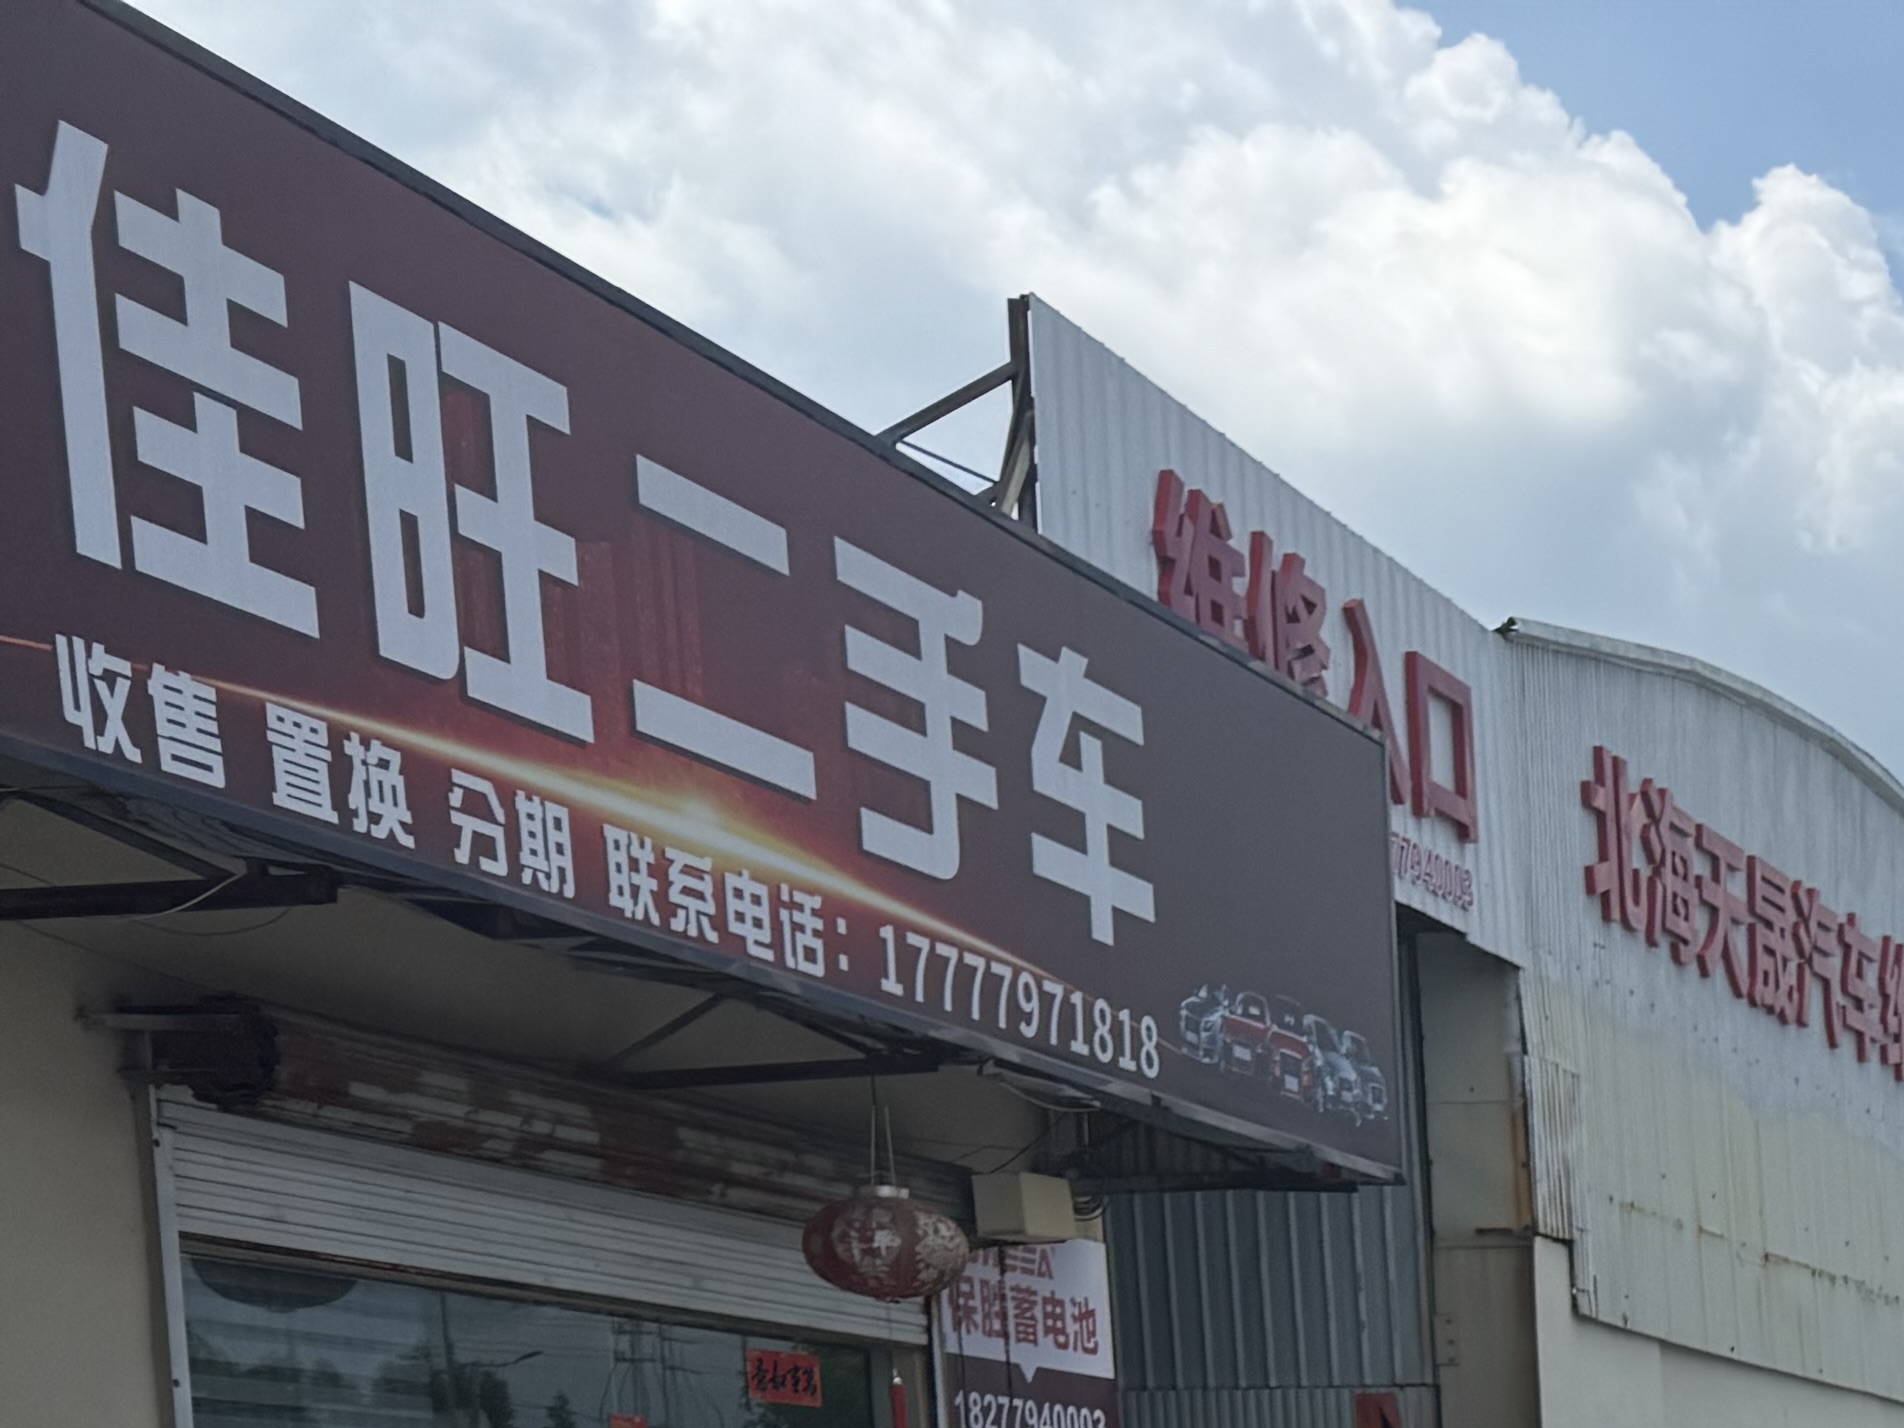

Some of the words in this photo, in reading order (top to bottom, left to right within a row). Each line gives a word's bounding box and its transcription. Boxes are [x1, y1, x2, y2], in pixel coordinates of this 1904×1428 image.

[14, 119, 1156, 946] 佳旺二手车
[1152, 468, 1478, 843] 维修入口
[54, 633, 226, 789] 收售
[265, 700, 416, 850] 置换
[449, 767, 576, 900] 分期
[879, 923, 1161, 1080] 17777971818
